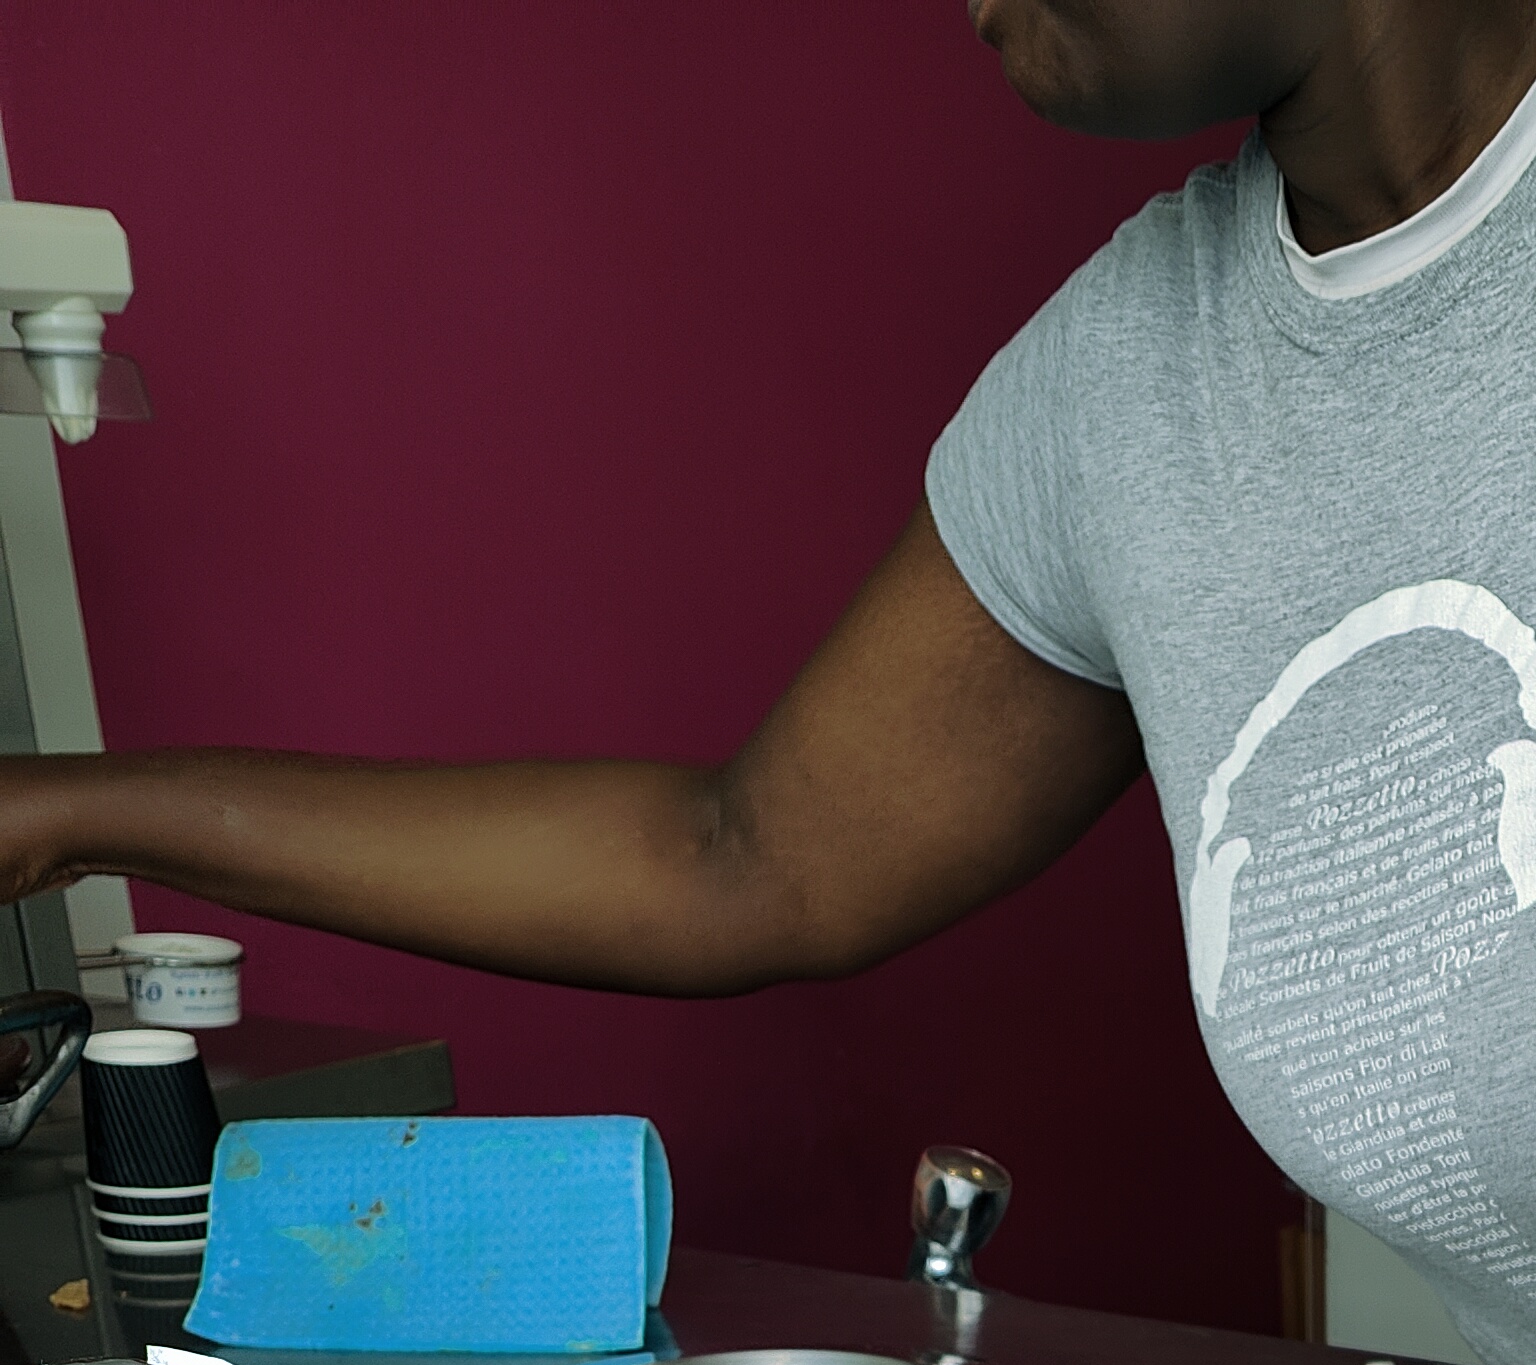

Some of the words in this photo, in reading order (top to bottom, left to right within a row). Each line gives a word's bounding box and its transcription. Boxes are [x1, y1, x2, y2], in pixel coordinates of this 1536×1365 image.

[1306, 775, 1416, 831] Pozzetto
[1368, 797, 1427, 834] parfums
[1254, 889, 1288, 912] frais
[1292, 868, 1359, 902] français
[1380, 853, 1400, 871] de
[1402, 836, 1440, 862] fruits
[1441, 816, 1476, 842] frais
[1297, 906, 1322, 923] sur
[1324, 897, 1340, 913] le
[1405, 848, 1463, 883] Gelato
[1466, 832, 1495, 856] fait
[1229, 945, 1336, 993] Pozzetto
[1336, 941, 1375, 968] pour
[1376, 918, 1428, 951] obtenir
[1431, 908, 1451, 928] un
[1455, 887, 1500, 917] goût
[1251, 928, 1314, 958] français
[1317, 916, 1357, 938] selon
[1360, 906, 1388, 926] des
[1390, 877, 1449, 913] recettes
[1259, 976, 1321, 1007] Sorbets
[1326, 968, 1347, 987] de
[1350, 953, 1391, 980] Fruit
[1395, 945, 1417, 963] de
[1420, 919, 1476, 953] Saison
[1267, 1013, 1319, 1038] sorbets
[1323, 999, 1367, 1021] qu'on
[1370, 986, 1395, 1005] fait
[1399, 972, 1431, 995] chez
[1286, 1025, 1337, 1051] revient
[1341, 984, 1449, 1035] principalement
[1281, 1056, 1307, 1077] que
[1312, 1049, 1339, 1066] l'on
[1344, 1027, 1395, 1056] achète
[1398, 1020, 1422, 1037] sur
[1425, 1010, 1446, 1028] les
[1290, 1066, 1355, 1099] saisons
[1359, 1054, 1394, 1077] Fior
[1400, 1043, 1418, 1063] di
[1305, 1101, 1400, 1145] ozzetto
[1403, 1089, 1457, 1116] crèmes
[1309, 1093, 1351, 1117] qu'en
[1353, 1077, 1393, 1100] Italie
[1397, 1070, 1418, 1086] on
[1339, 1125, 1406, 1157] Gianduia
[1409, 1117, 1425, 1131] et
[1428, 1106, 1458, 1124] cela
[1385, 1126, 1465, 1165] Fondente
[1356, 1162, 1432, 1198] Gianduia
[1374, 1183, 1430, 1213] noisette
[1411, 1192, 1452, 1216] d'être
[1453, 1187, 1468, 1199] la
[1405, 1200, 1487, 1235] Pistacchio
[1445, 1227, 1511, 1254] Nocciola
